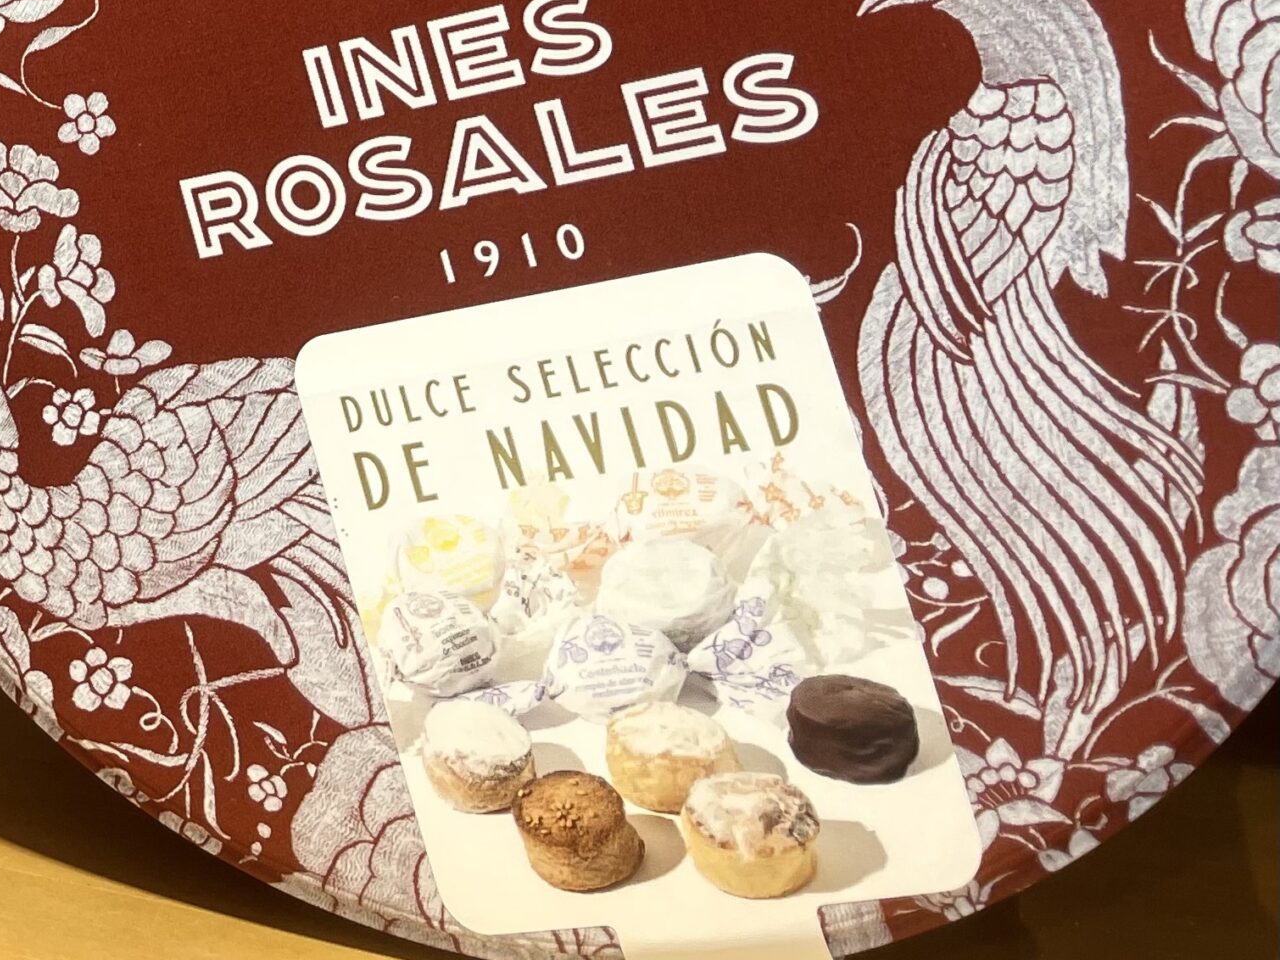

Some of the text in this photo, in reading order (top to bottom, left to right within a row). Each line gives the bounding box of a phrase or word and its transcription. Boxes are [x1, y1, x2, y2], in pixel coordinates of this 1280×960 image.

[179, 52, 819, 259] ROSALES
[439, 223, 585, 284] 1910
[340, 319, 777, 433] DULCE SELECCIÓN
[352, 383, 801, 511] DE NAVIDAD
